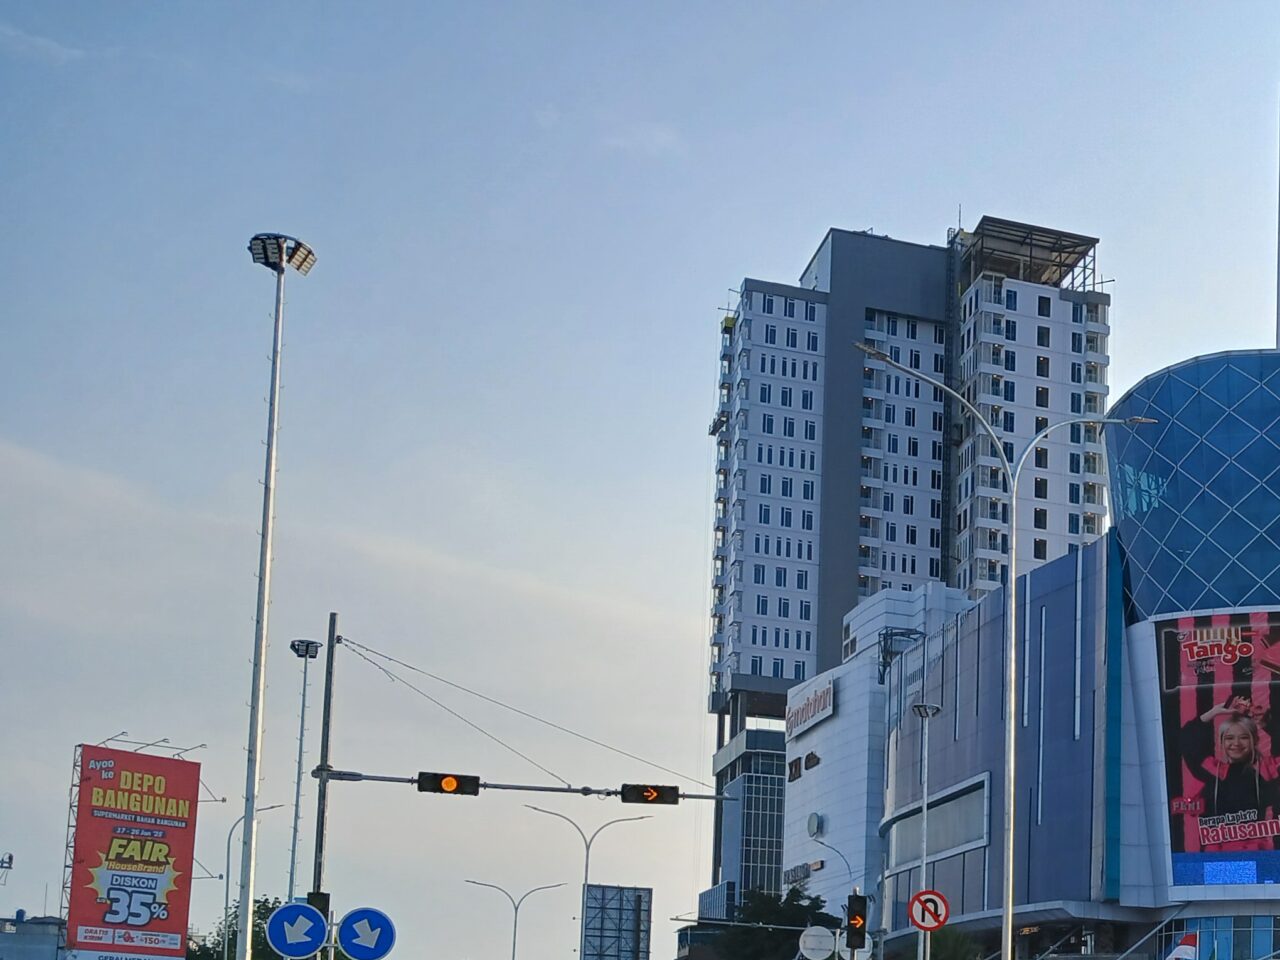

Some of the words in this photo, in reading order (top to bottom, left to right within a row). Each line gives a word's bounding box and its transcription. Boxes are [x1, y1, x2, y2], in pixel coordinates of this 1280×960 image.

[1182, 641, 1254, 665] Tango
[793, 680, 832, 727] matahari
[89, 759, 114, 770] Ayoo
[101, 770, 114, 779] ke
[119, 770, 166, 795] DEPO
[91, 787, 190, 818] BANGUNAN
[93, 810, 135, 822] SUPERMARKET
[156, 817, 186, 828] BANGUNAN
[1199, 816, 1226, 827] Berapa
[107, 838, 170, 863] FAIR
[108, 861, 164, 873] HouseBrand
[112, 875, 157, 889] DISKON
[104, 887, 169, 926] 35%
